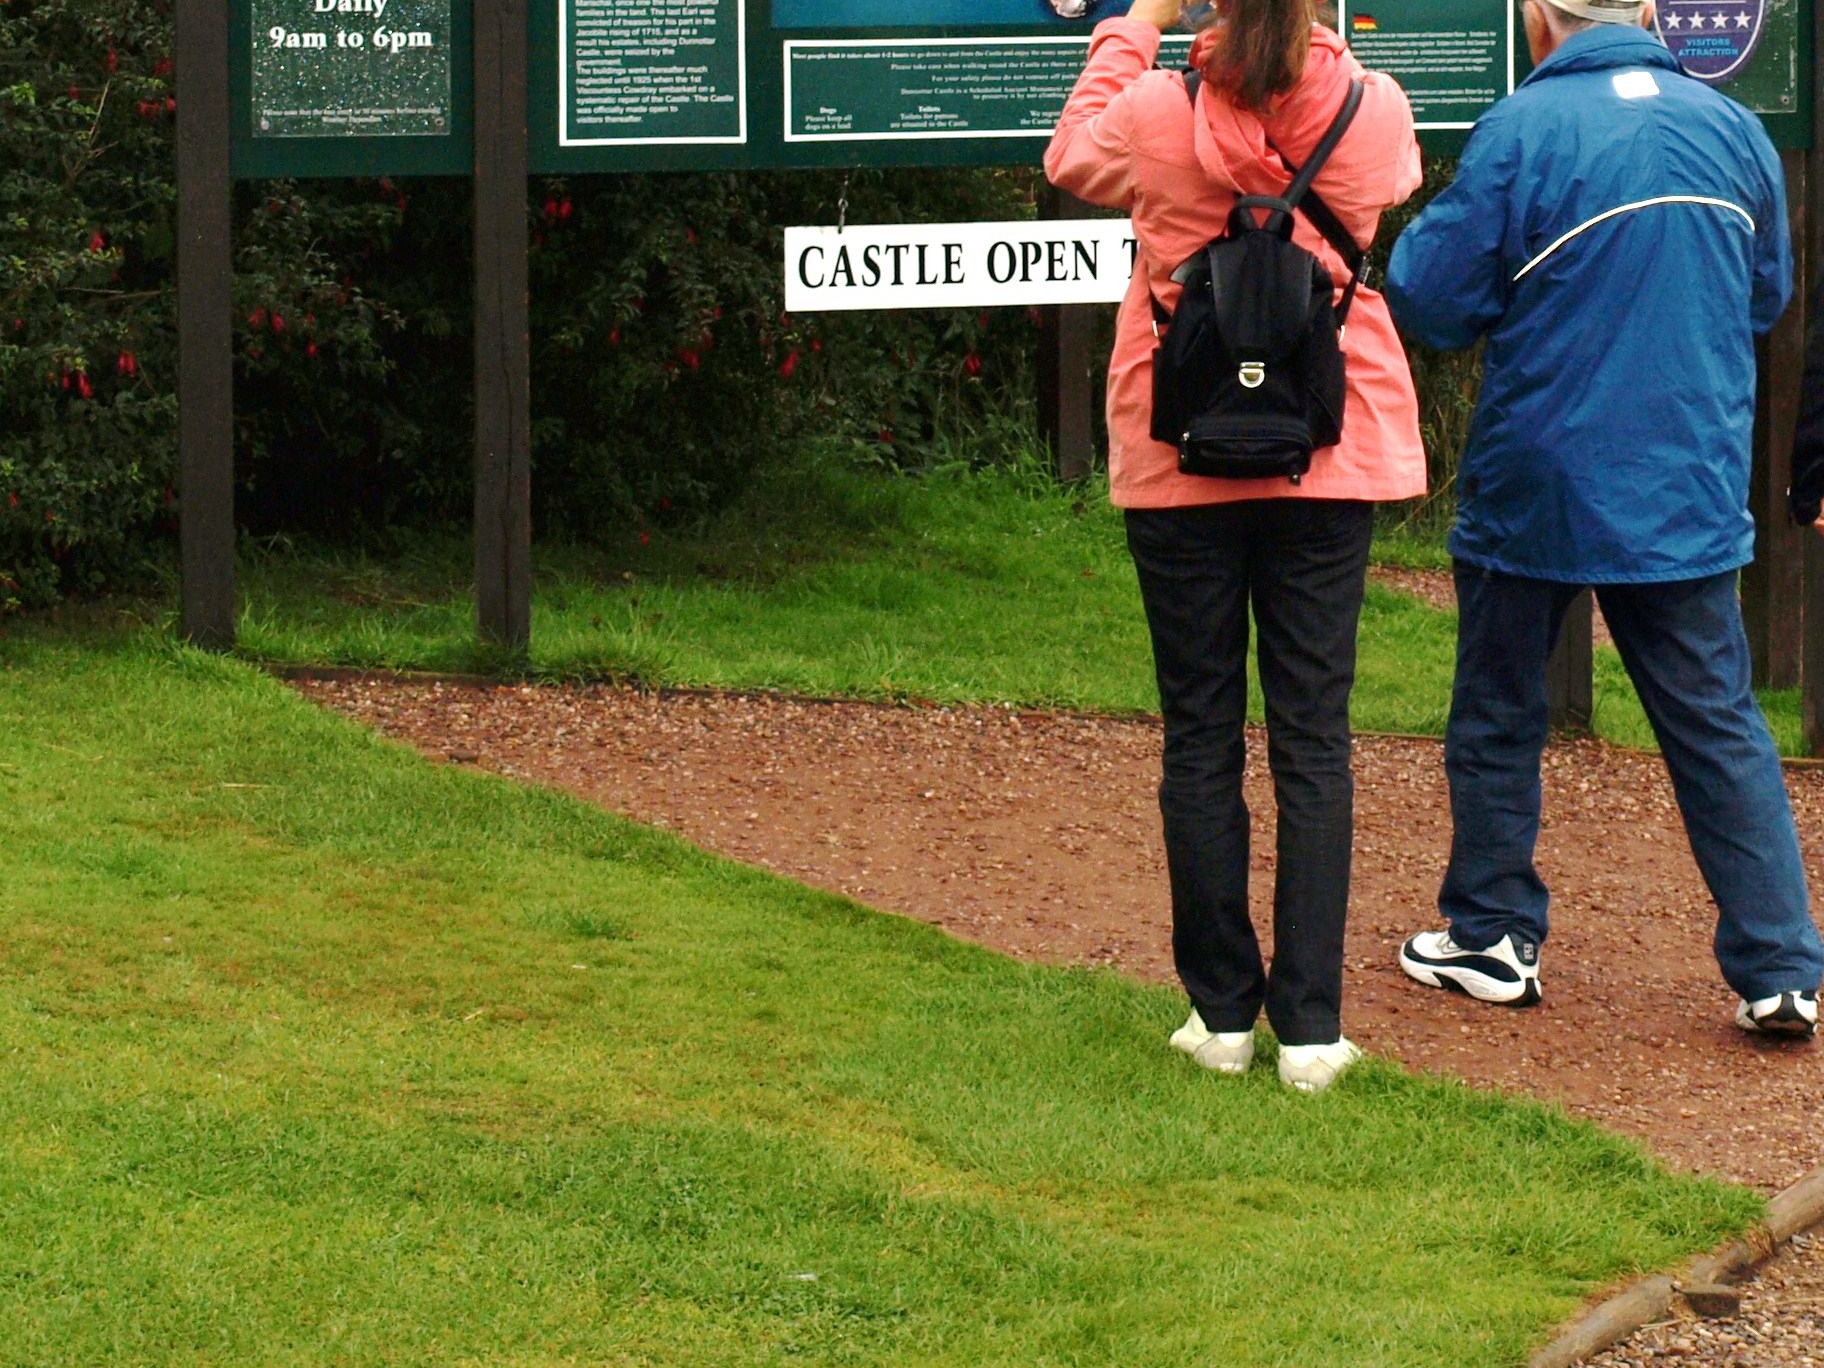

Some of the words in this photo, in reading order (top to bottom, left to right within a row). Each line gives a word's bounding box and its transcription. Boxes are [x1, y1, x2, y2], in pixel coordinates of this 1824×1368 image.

[270, 27, 327, 48] 9am
[337, 30, 363, 47] to
[373, 26, 432, 53] 6pm
[1687, 38, 1731, 46] VISITORS
[1678, 47, 1738, 57] ATTRACTION
[798, 243, 965, 289] CASTLE
[987, 239, 1099, 284] OPEN
